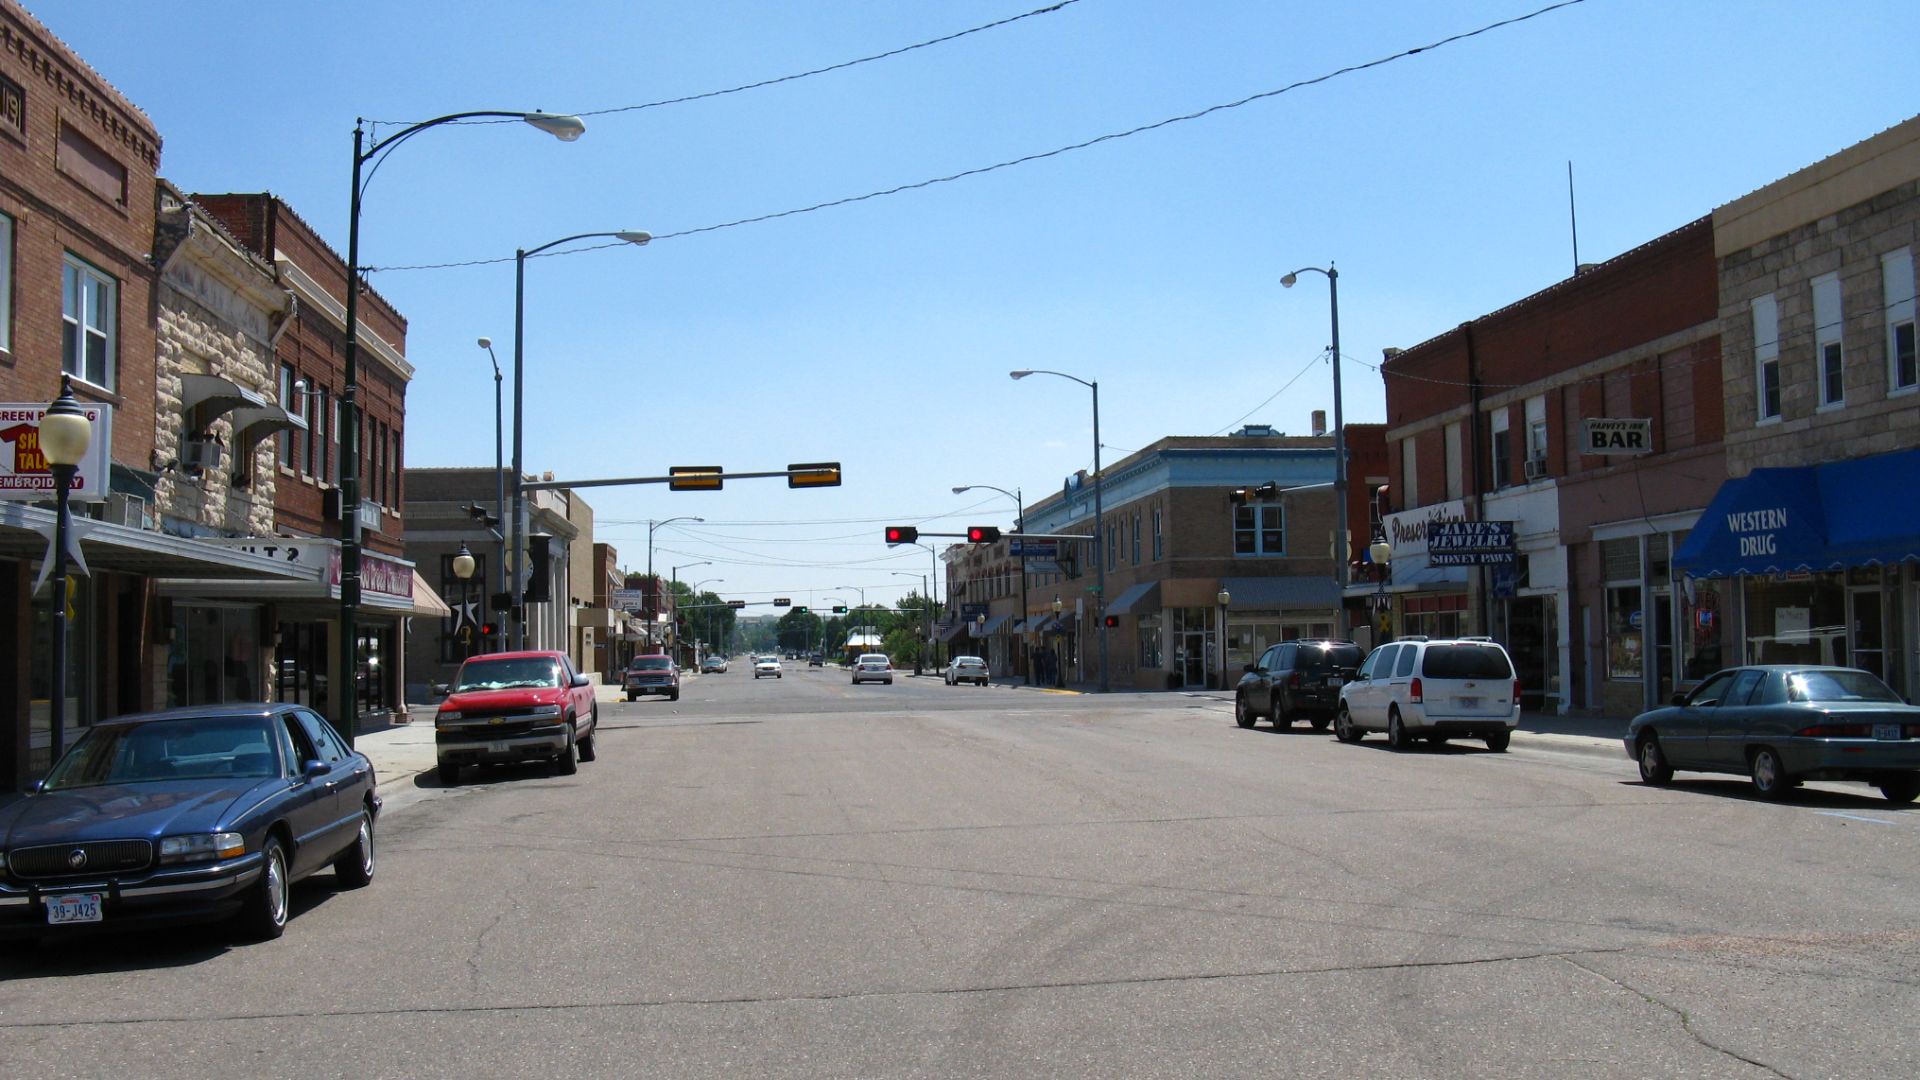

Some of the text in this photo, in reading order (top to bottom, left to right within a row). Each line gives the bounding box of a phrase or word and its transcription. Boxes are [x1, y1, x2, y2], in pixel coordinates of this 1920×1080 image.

[1592, 431, 1643, 449] BAR
[1727, 507, 1787, 533] WESTERN
[1429, 534, 1511, 548] JEWELRY
[1740, 533, 1777, 557] DRUG
[1431, 553, 1514, 564] SIDNEY PAWN
[53, 903, 97, 919] 39-J425
